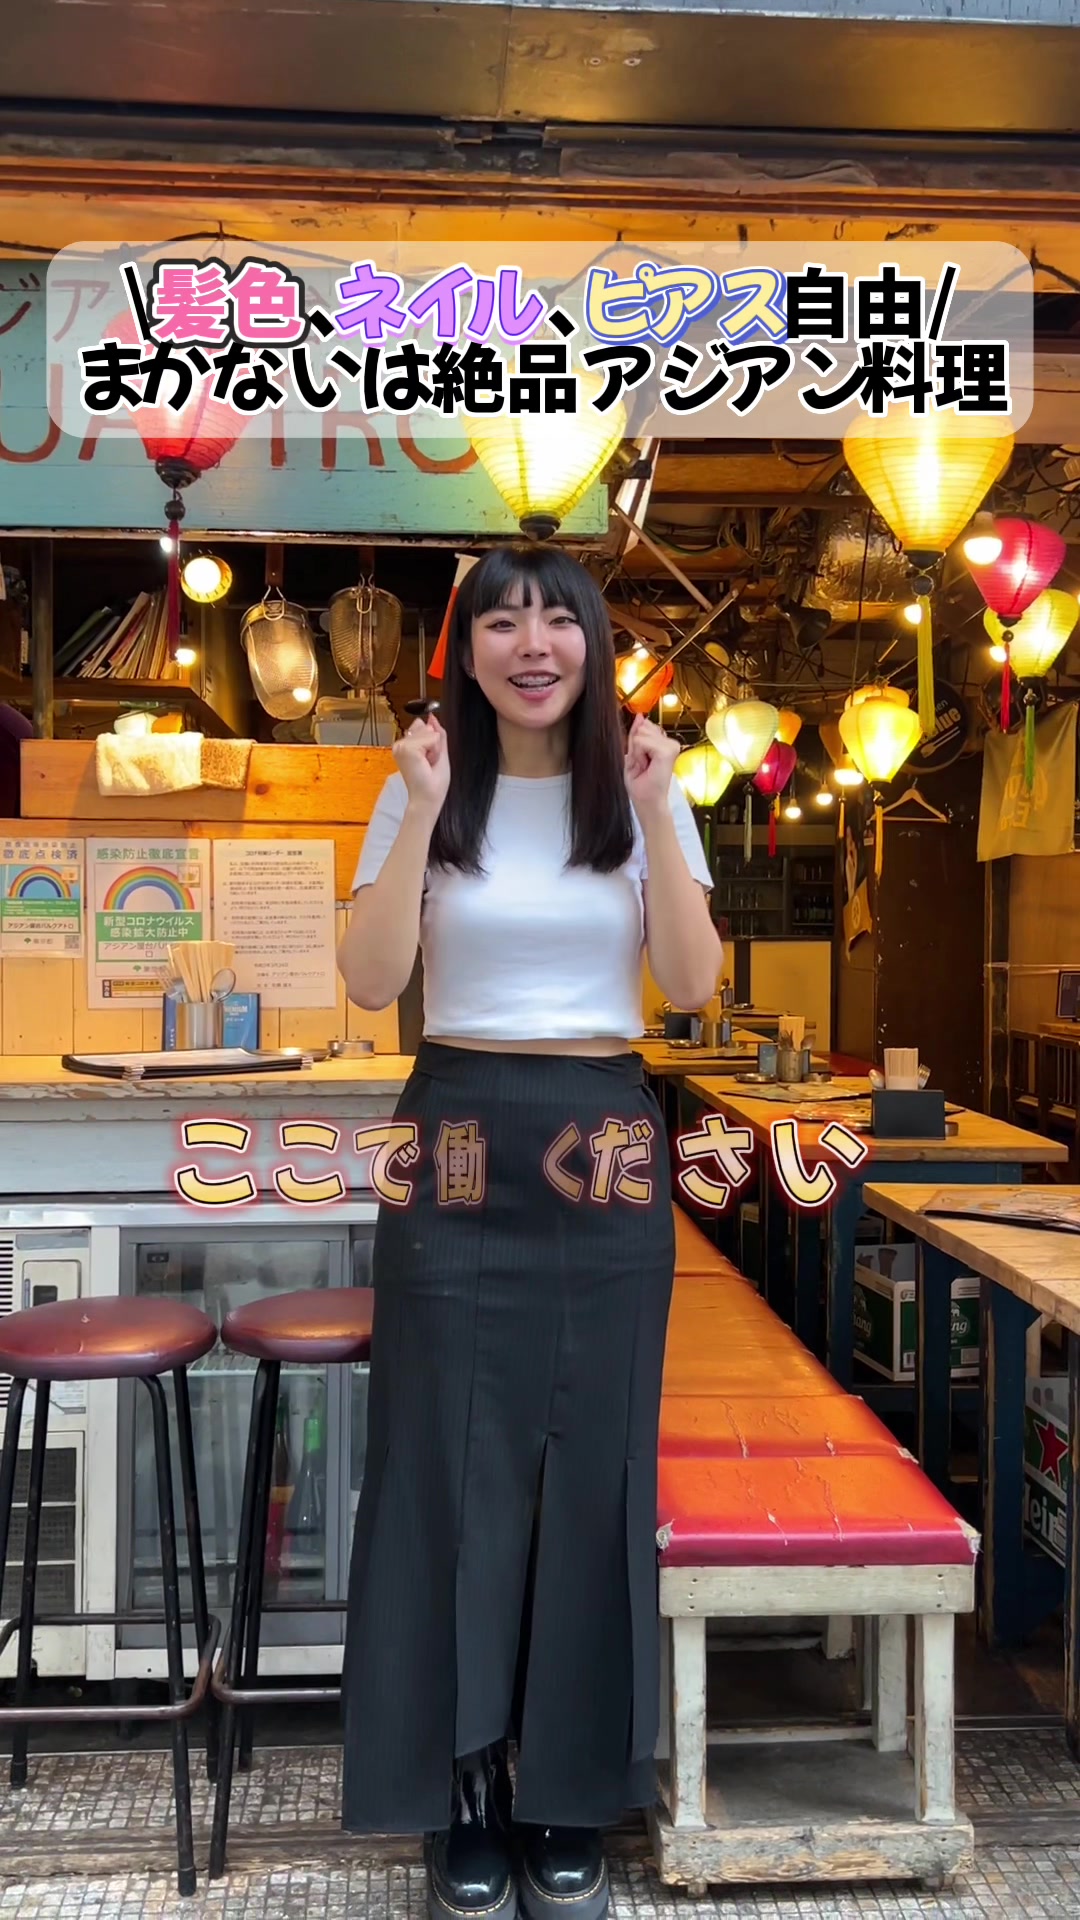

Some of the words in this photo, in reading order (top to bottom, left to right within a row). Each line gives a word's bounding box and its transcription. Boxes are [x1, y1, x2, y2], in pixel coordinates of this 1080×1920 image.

[96, 847, 200, 861] 感染防止徹底宣言
[103, 916, 195, 927] 新型コロナウイルス
[110, 928, 189, 939] 感染拡大防止中
